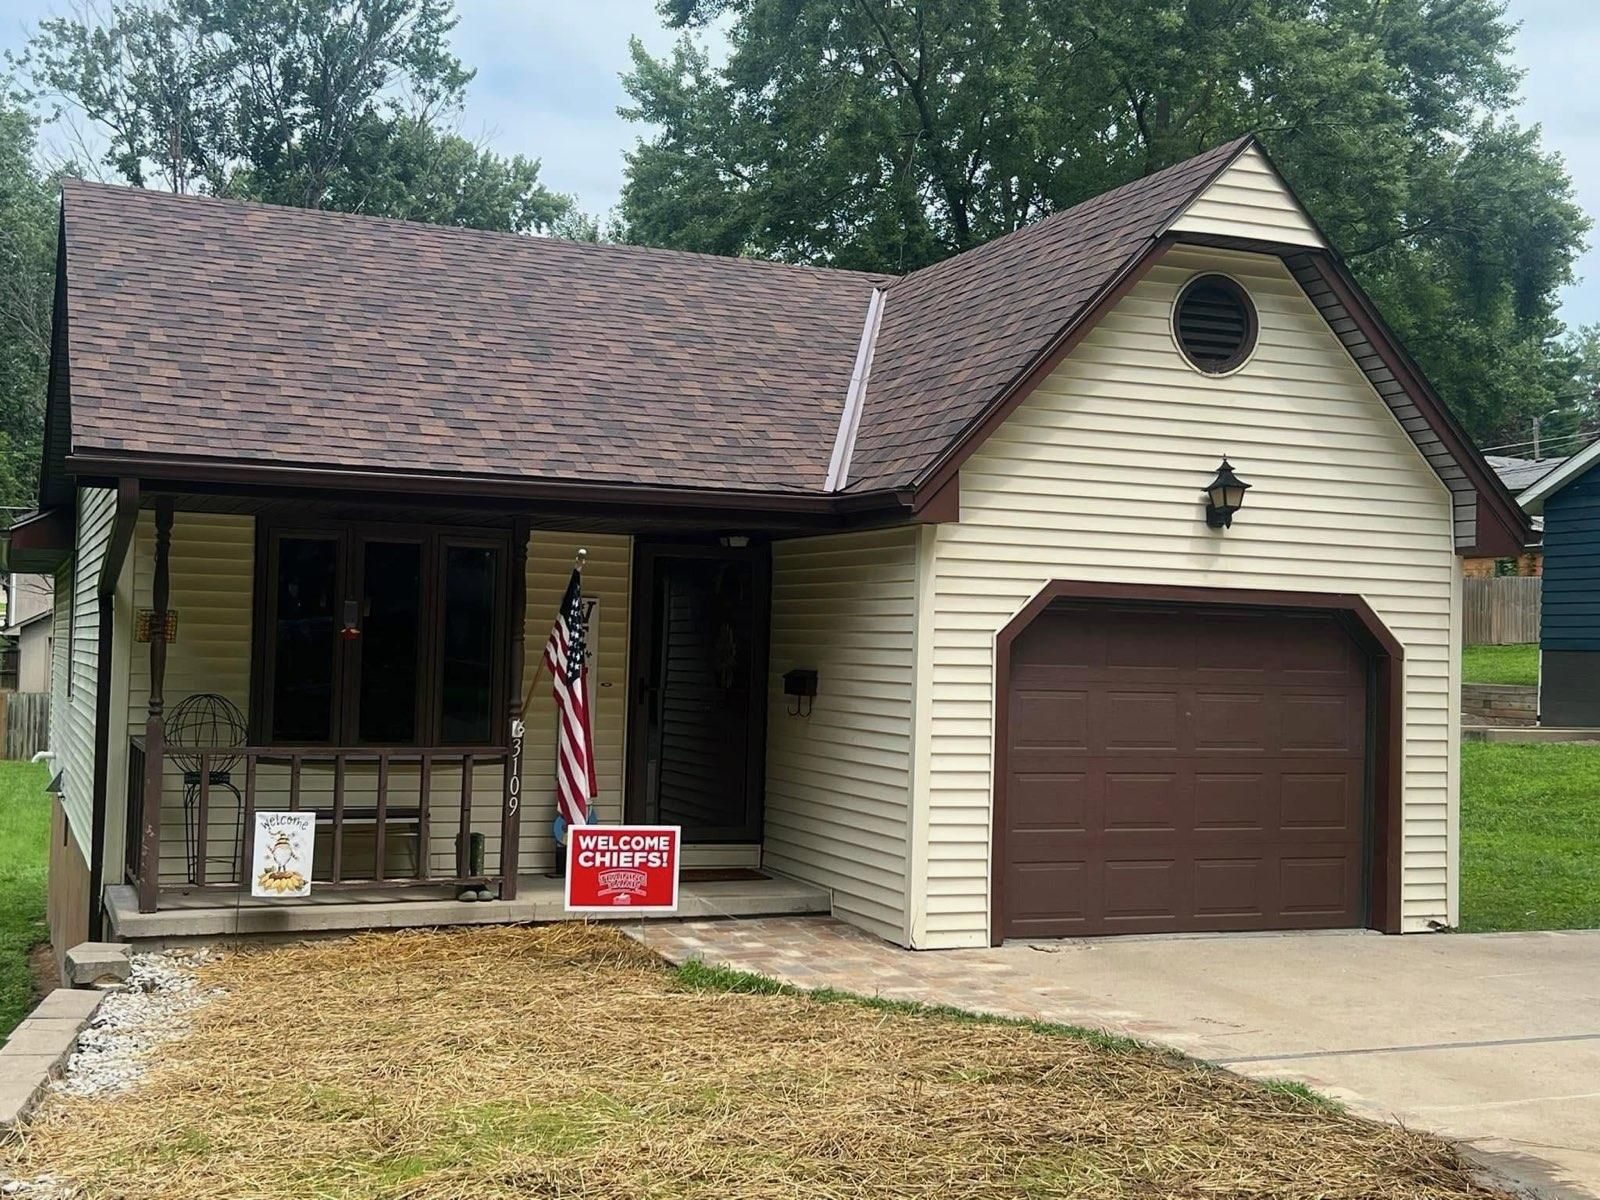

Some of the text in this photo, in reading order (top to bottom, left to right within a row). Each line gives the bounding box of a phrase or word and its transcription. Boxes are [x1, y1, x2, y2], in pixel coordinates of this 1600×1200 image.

[509, 738, 521, 816] 3109
[578, 835, 670, 850] WELCOME
[578, 851, 668, 867] CHIEFS!
